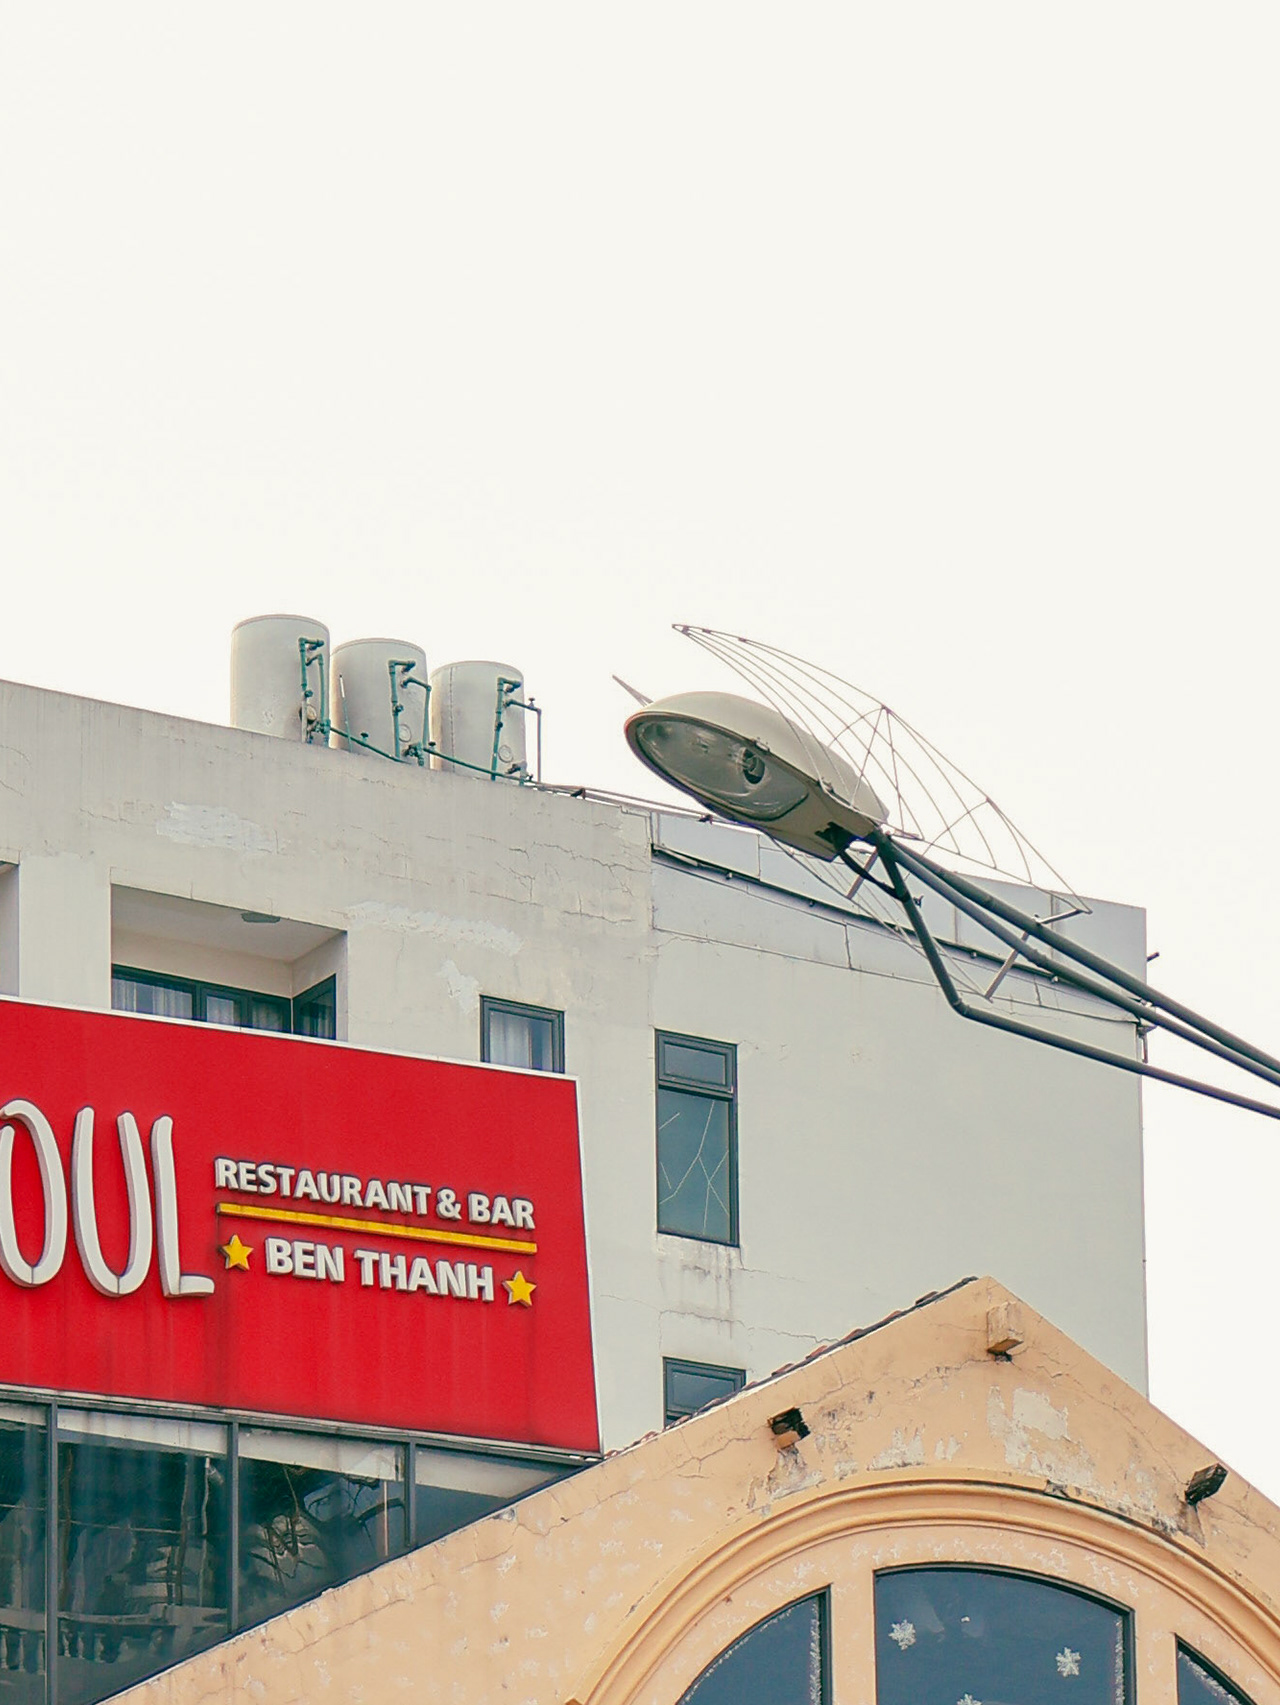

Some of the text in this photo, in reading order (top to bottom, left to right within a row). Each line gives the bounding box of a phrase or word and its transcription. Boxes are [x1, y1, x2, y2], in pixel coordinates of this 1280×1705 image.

[214, 1157, 536, 1231] RESTAURANT & BAR
[265, 1237, 495, 1303] BEN THANH
